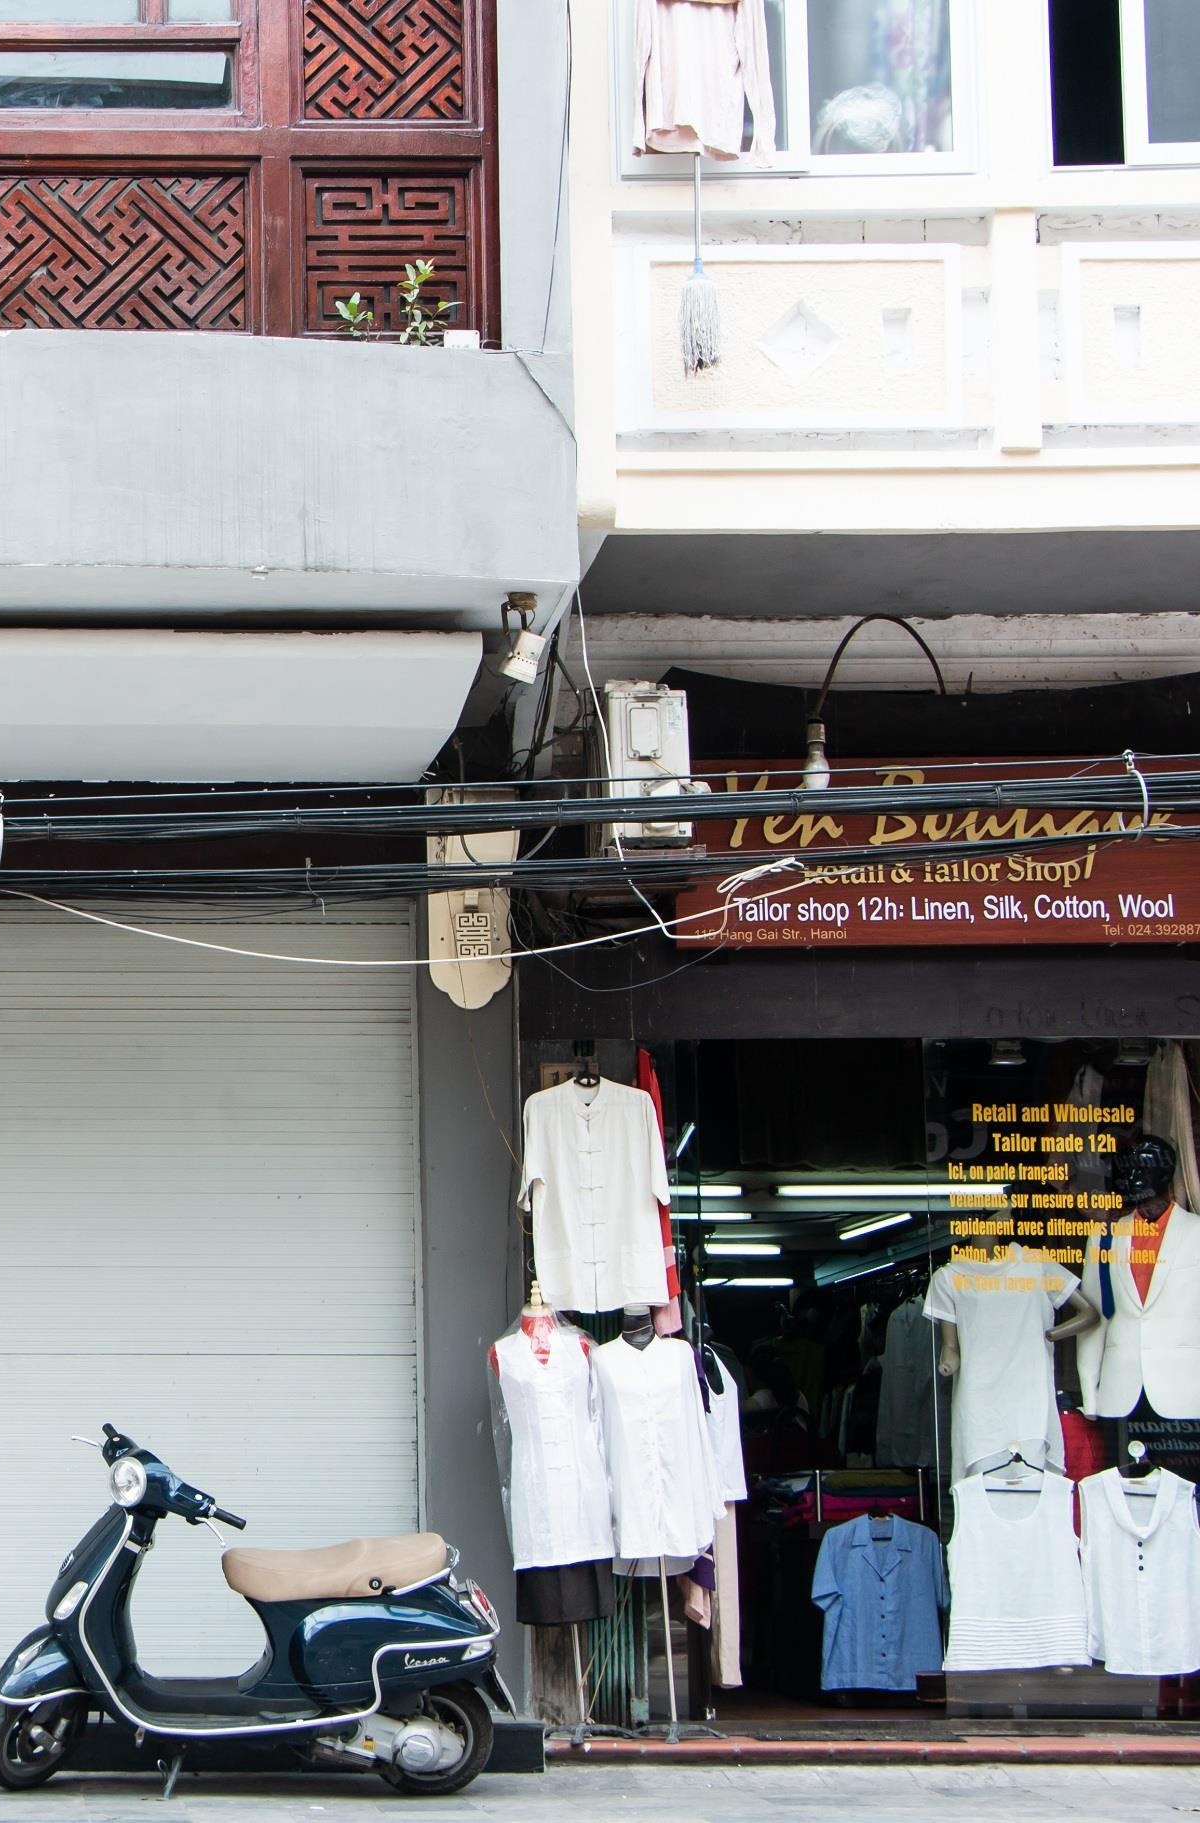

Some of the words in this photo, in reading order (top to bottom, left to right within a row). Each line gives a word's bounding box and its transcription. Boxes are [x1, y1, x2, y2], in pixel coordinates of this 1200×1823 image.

[891, 862, 914, 884] &
[1008, 853, 1081, 888] Shop
[733, 897, 791, 922] Tailor
[797, 897, 850, 926] shop
[857, 896, 904, 922] 12h:
[911, 896, 975, 924] Linen,
[983, 894, 1028, 923] Silk,
[1034, 894, 1110, 922] Cotton,
[1117, 893, 1174, 918] Wool
[720, 928, 753, 942] Hang
[756, 928, 779, 940] Gai
[810, 927, 848, 940] Hanoi
[1101, 924, 1124, 936] Tel:
[972, 1103, 1017, 1123] Retail
[1021, 1103, 1050, 1123] and
[1053, 1103, 1135, 1123] Wholesale
[992, 1132, 1037, 1152] Tailor
[1040, 1132, 1084, 1153] made
[1087, 1133, 1117, 1153] 12h
[948, 1162, 967, 1182] Ici,
[969, 1165, 984, 1181] on
[986, 1162, 1016, 1183] parle
[1018, 1163, 1069, 1185] français!
[1011, 1193, 1029, 1208] sur
[1031, 1193, 1074, 1208] mesure
[1076, 1192, 1089, 1209] et
[1091, 1191, 1123, 1210] copie
[950, 1218, 1015, 1237] rapidement
[1017, 1219, 1044, 1236] avec
